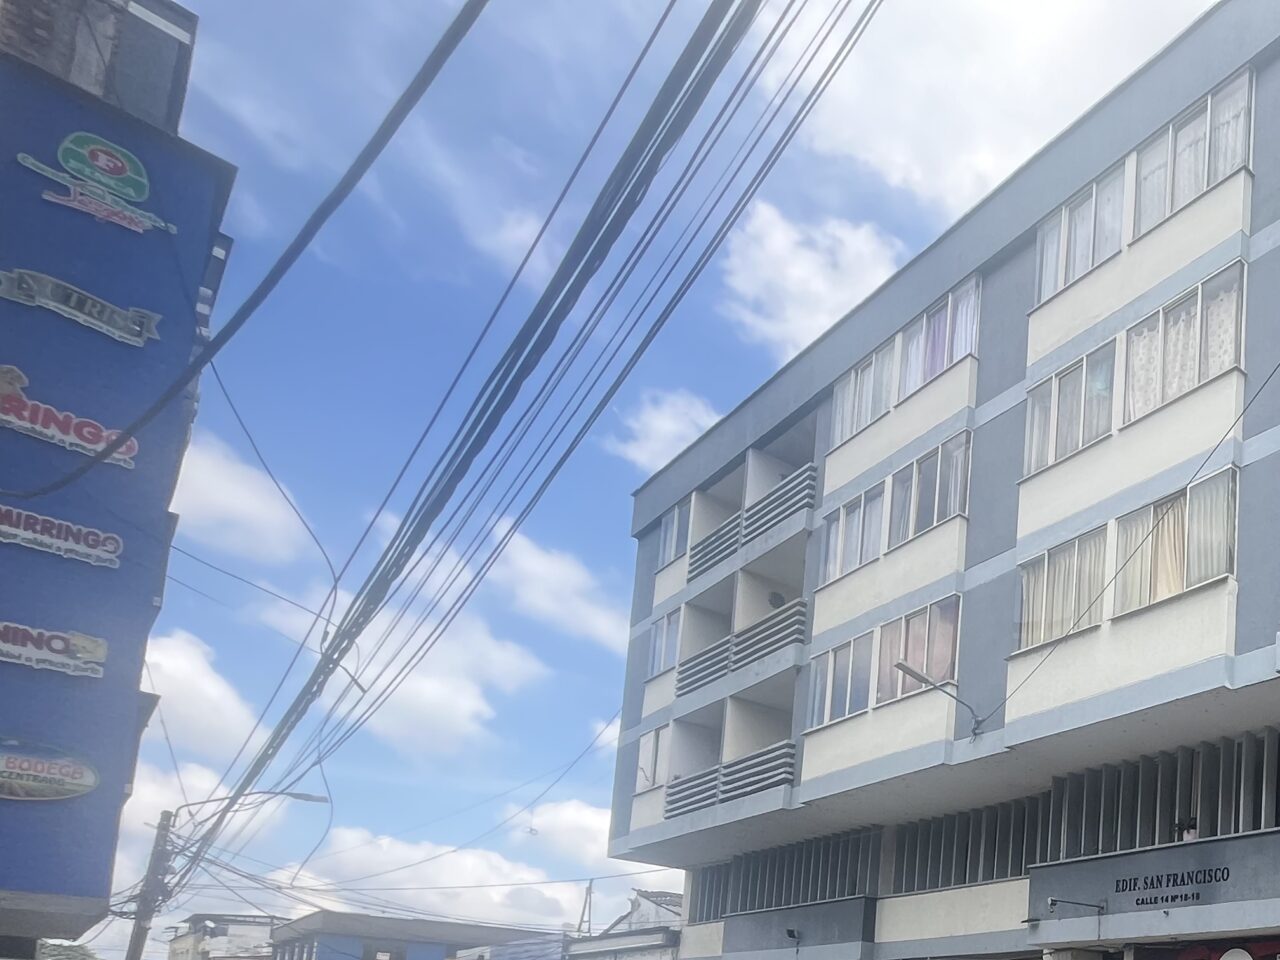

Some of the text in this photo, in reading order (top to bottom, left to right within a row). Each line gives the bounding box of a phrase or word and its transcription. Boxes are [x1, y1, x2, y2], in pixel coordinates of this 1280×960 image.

[1115, 866, 1230, 893] EDIF. SAN FRANCISCO
[1135, 896, 1159, 906] CALLE
[1160, 895, 1169, 904] 14
